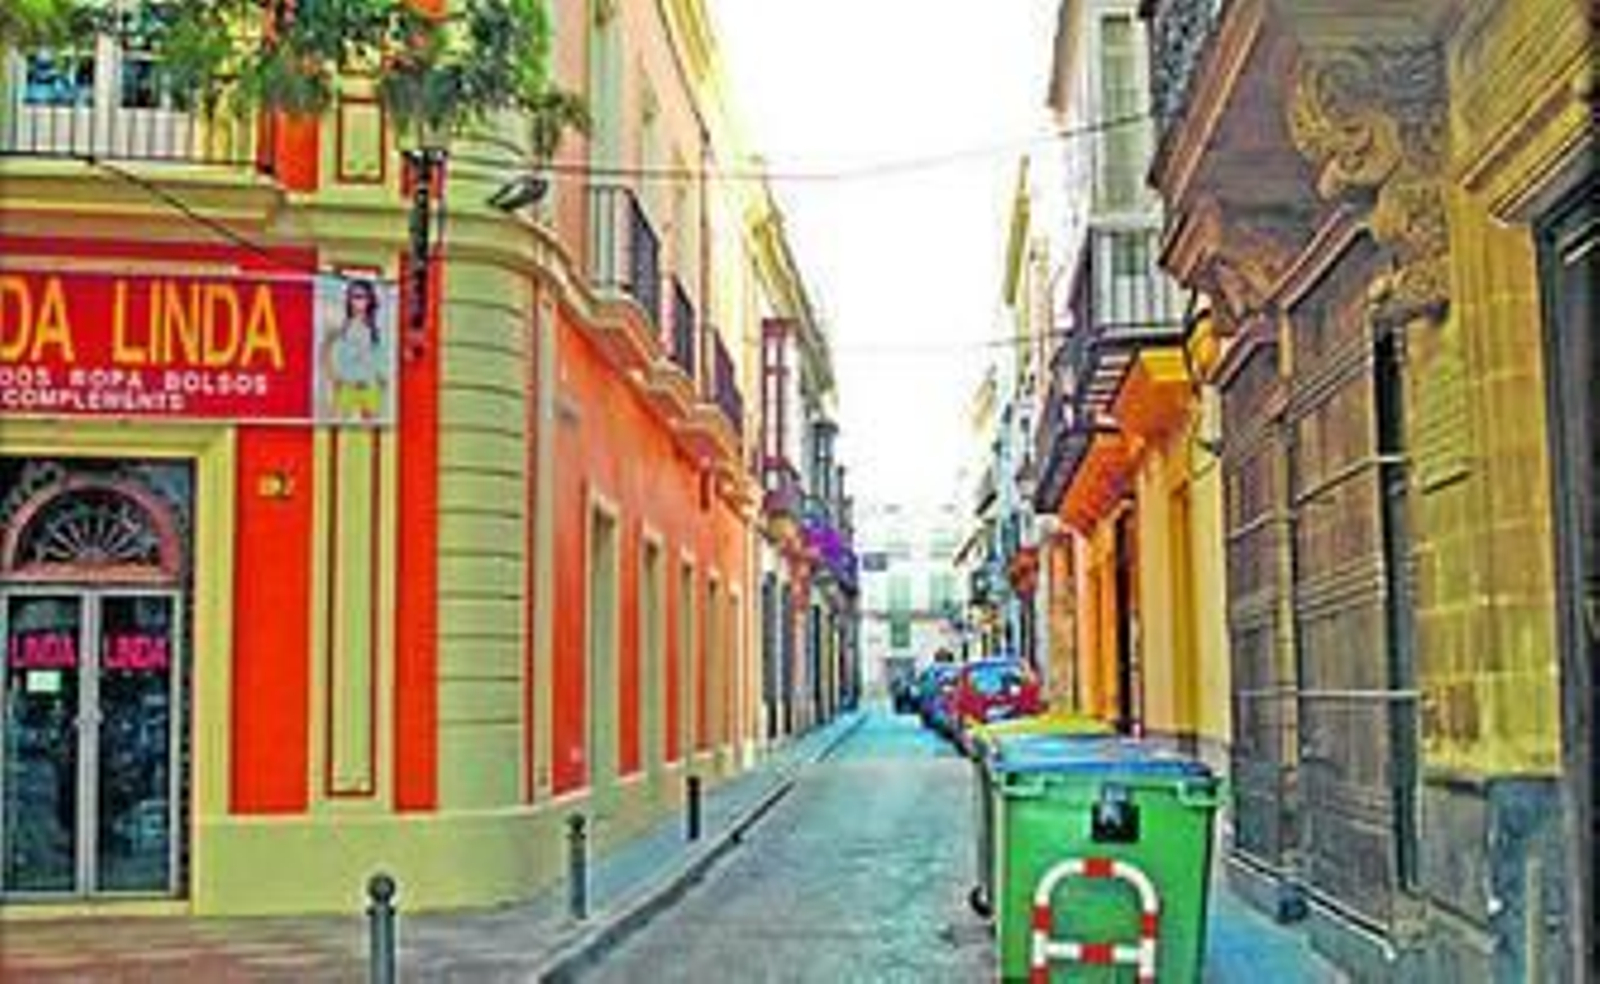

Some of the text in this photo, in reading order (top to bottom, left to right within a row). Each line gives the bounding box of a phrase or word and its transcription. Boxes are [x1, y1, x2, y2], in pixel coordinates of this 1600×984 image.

[112, 281, 284, 368] LINDA
[69, 369, 143, 389] ROPA
[164, 371, 267, 395] BOLSOS
[11, 633, 169, 669] LINDA LINDA
